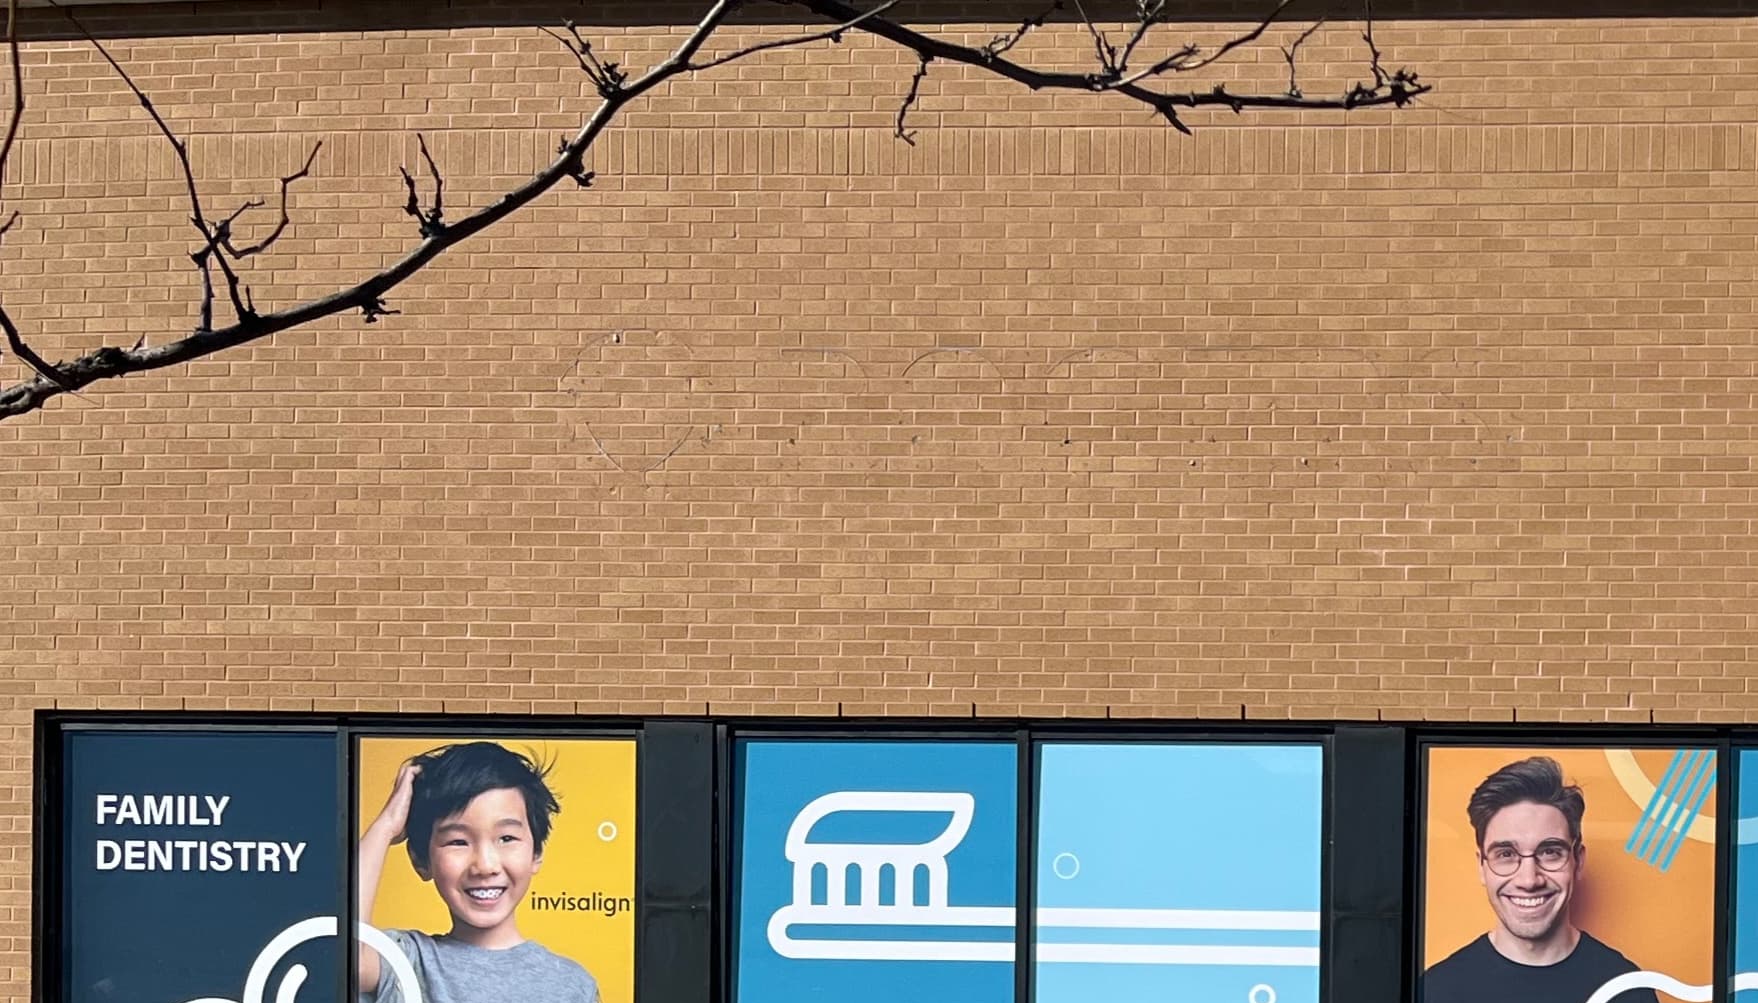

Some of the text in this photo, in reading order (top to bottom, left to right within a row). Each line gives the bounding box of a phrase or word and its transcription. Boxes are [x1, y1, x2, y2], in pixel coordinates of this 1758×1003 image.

[96, 794, 231, 826] FAMILY
[96, 839, 307, 872] DENTISTRY
[531, 891, 631, 917] invisalign
